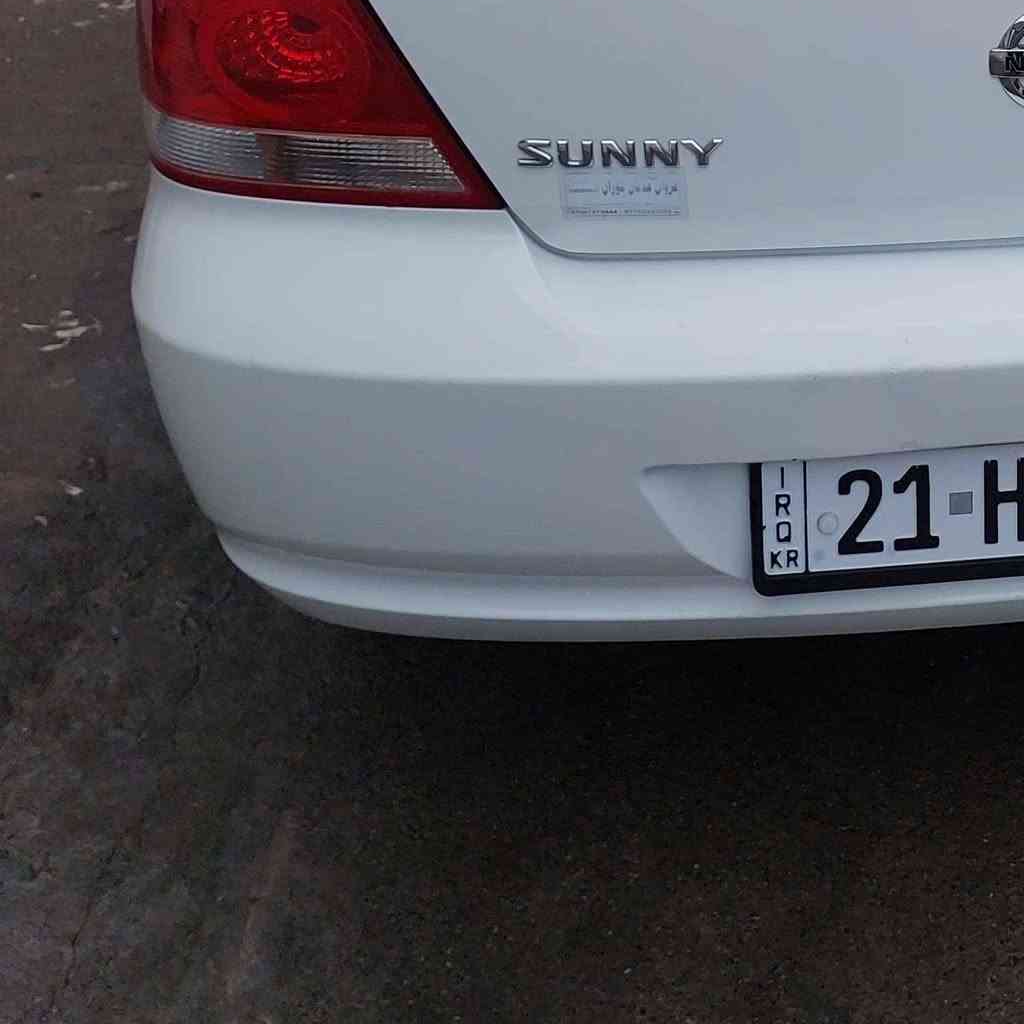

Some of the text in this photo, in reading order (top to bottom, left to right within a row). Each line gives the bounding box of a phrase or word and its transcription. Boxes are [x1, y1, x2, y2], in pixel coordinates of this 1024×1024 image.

[517, 139, 724, 168] SUNNY
[837, 463, 940, 555] 21
[770, 549, 799, 569] KR
